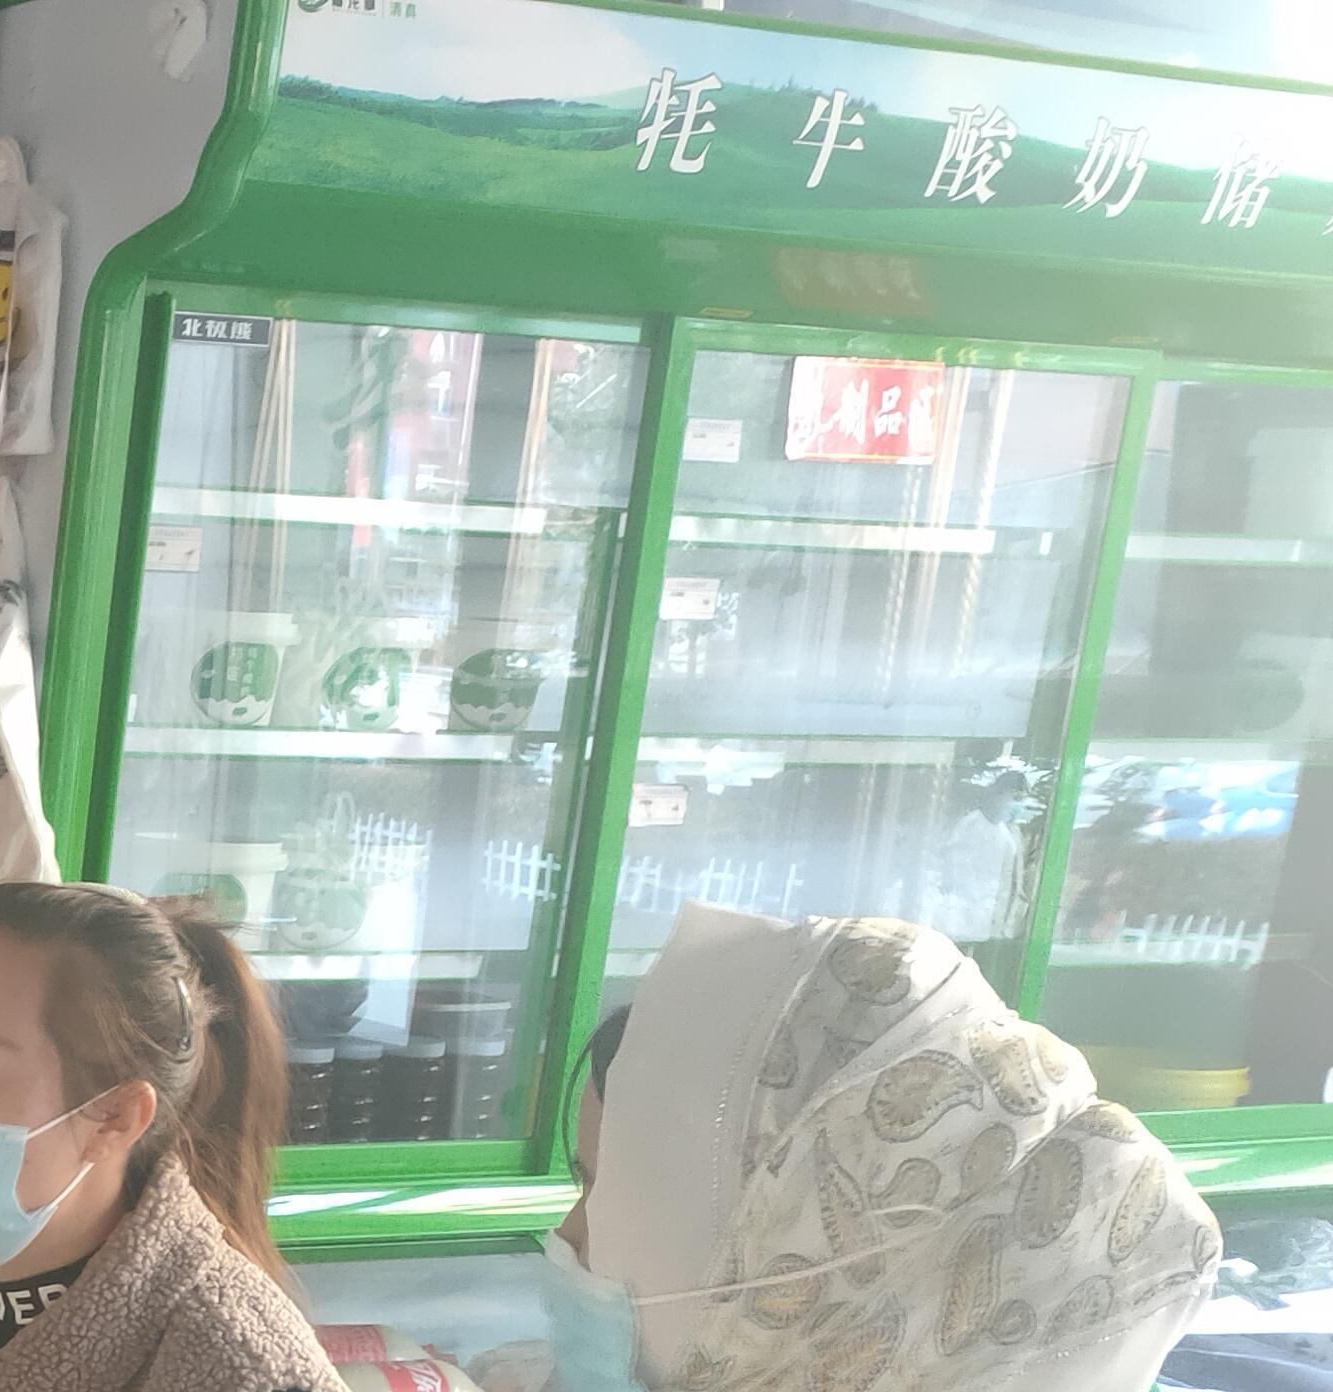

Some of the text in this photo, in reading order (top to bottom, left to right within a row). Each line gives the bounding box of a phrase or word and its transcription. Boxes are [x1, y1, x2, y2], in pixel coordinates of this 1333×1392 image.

[635, 67, 1333, 238] 牦牛酸奶储
